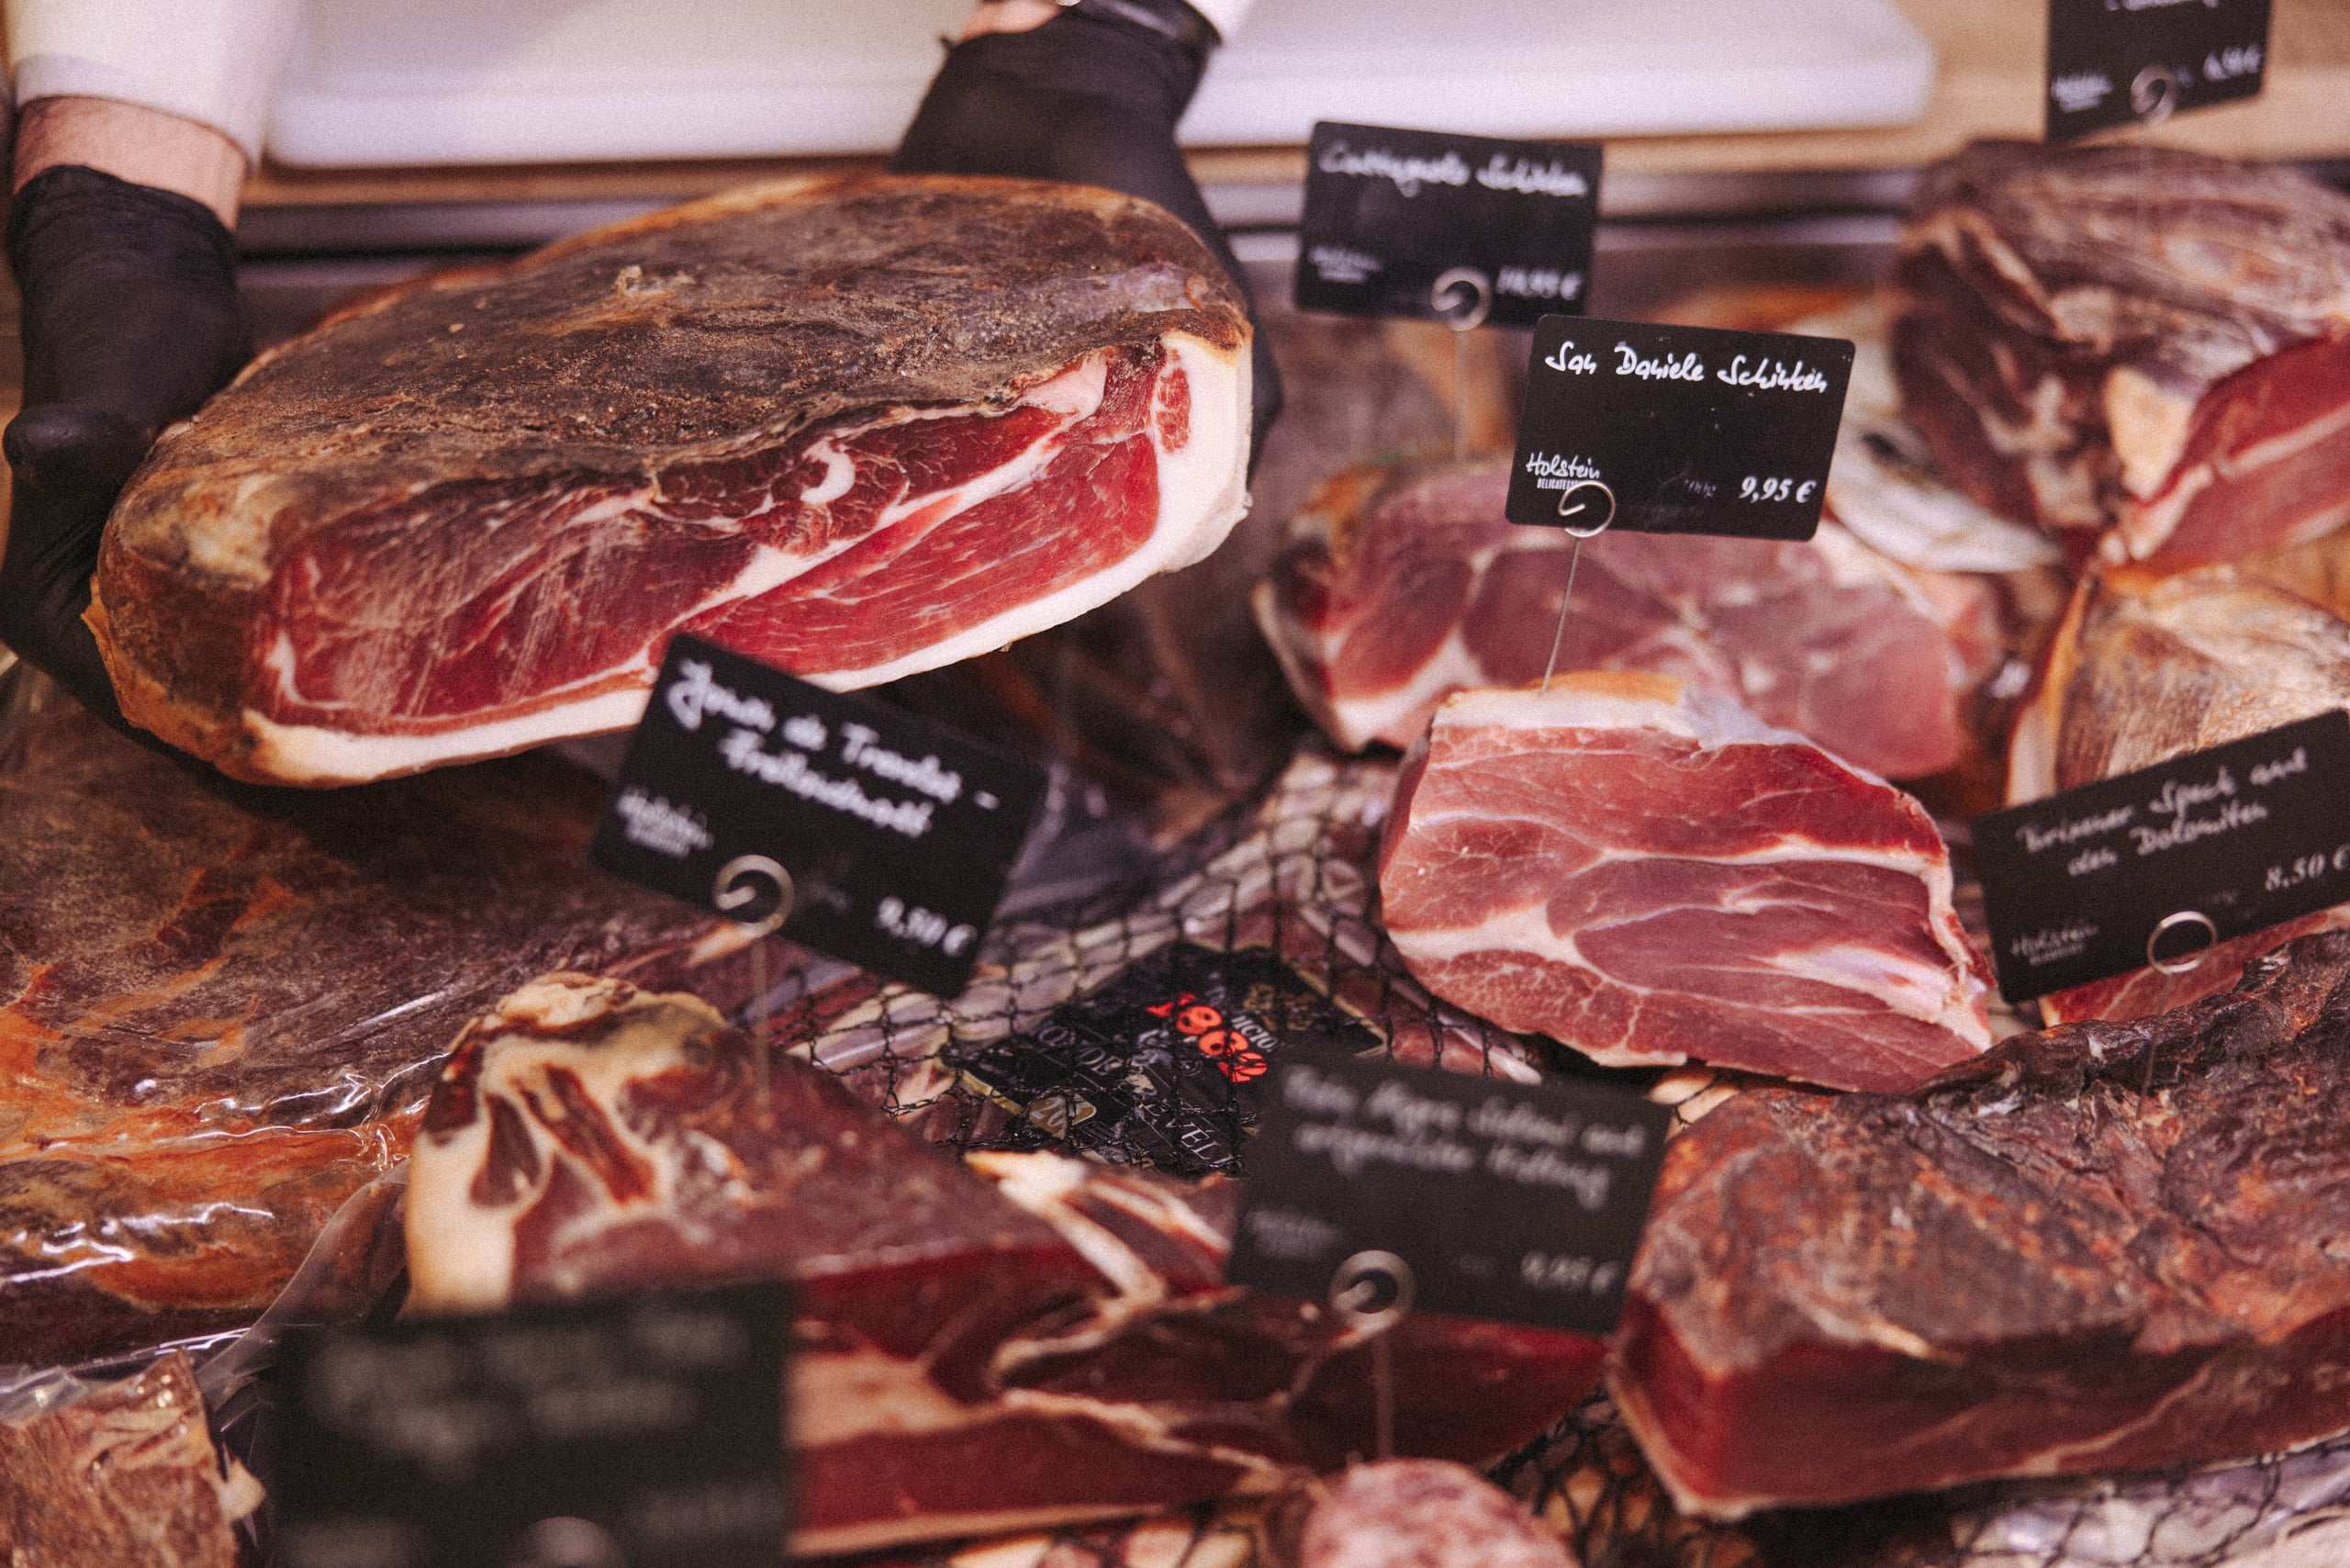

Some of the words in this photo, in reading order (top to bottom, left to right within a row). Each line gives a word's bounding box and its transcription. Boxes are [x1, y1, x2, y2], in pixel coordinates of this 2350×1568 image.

[1545, 341, 1597, 375] San
[1614, 343, 1705, 382] Daniele
[1717, 354, 1829, 393] Schinken
[1526, 451, 1601, 479] Holstein
[1738, 476, 1794, 504] 9,95
[1796, 479, 1818, 504] €
